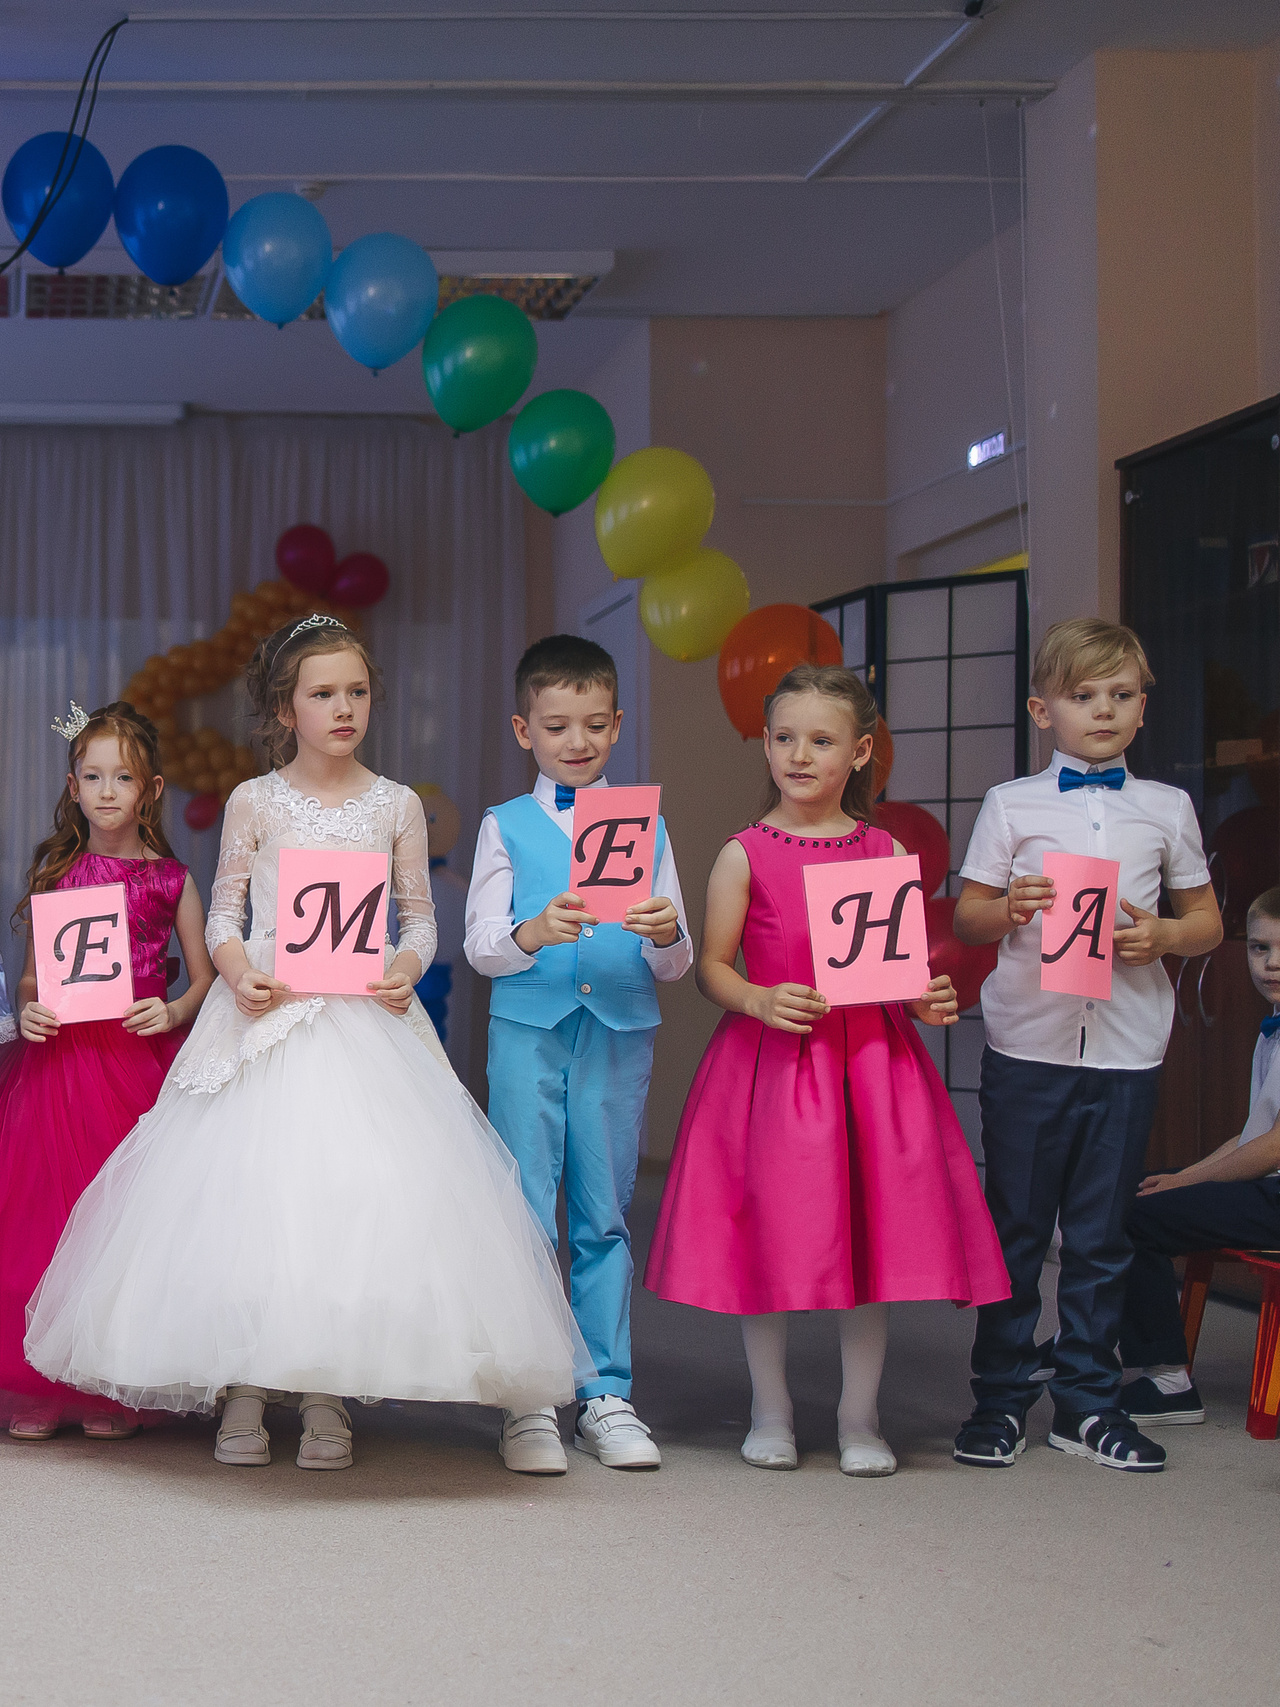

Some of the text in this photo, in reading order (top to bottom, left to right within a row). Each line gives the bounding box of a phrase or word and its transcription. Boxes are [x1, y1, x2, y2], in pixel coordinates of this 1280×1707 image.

[574, 816, 651, 888] Е
[53, 912, 122, 986] Е
[285, 880, 386, 955] М
[827, 879, 923, 969] Н
[1041, 886, 1108, 964] А
